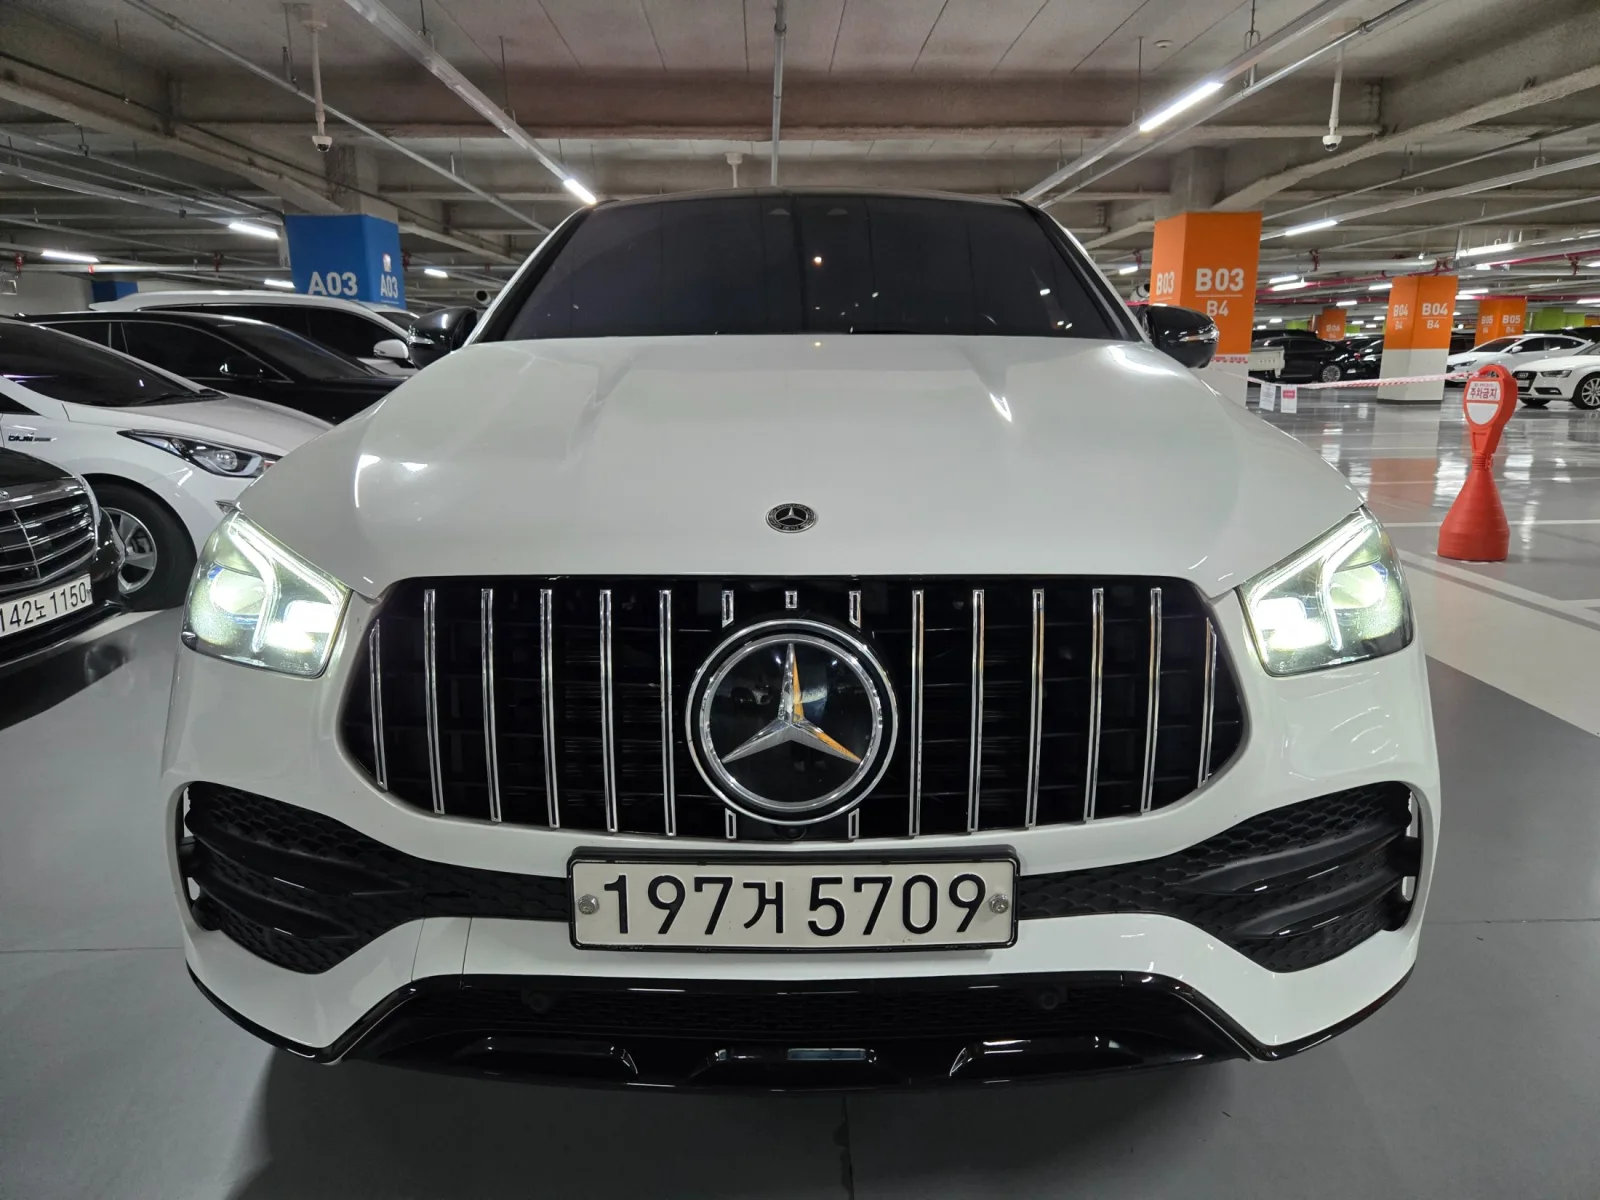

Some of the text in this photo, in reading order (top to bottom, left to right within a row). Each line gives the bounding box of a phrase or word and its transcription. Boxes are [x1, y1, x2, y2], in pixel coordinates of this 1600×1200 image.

[308, 271, 358, 296] A03
[381, 274, 398, 299] A03
[1156, 271, 1175, 295] B03
[1195, 268, 1244, 292] B03
[1206, 300, 1229, 317] B4
[1393, 304, 1408, 317] B04
[1422, 303, 1448, 315] B04
[1426, 320, 1440, 329] B4
[1502, 314, 1521, 324] B05
[1470, 387, 1498, 399] 주차금지
